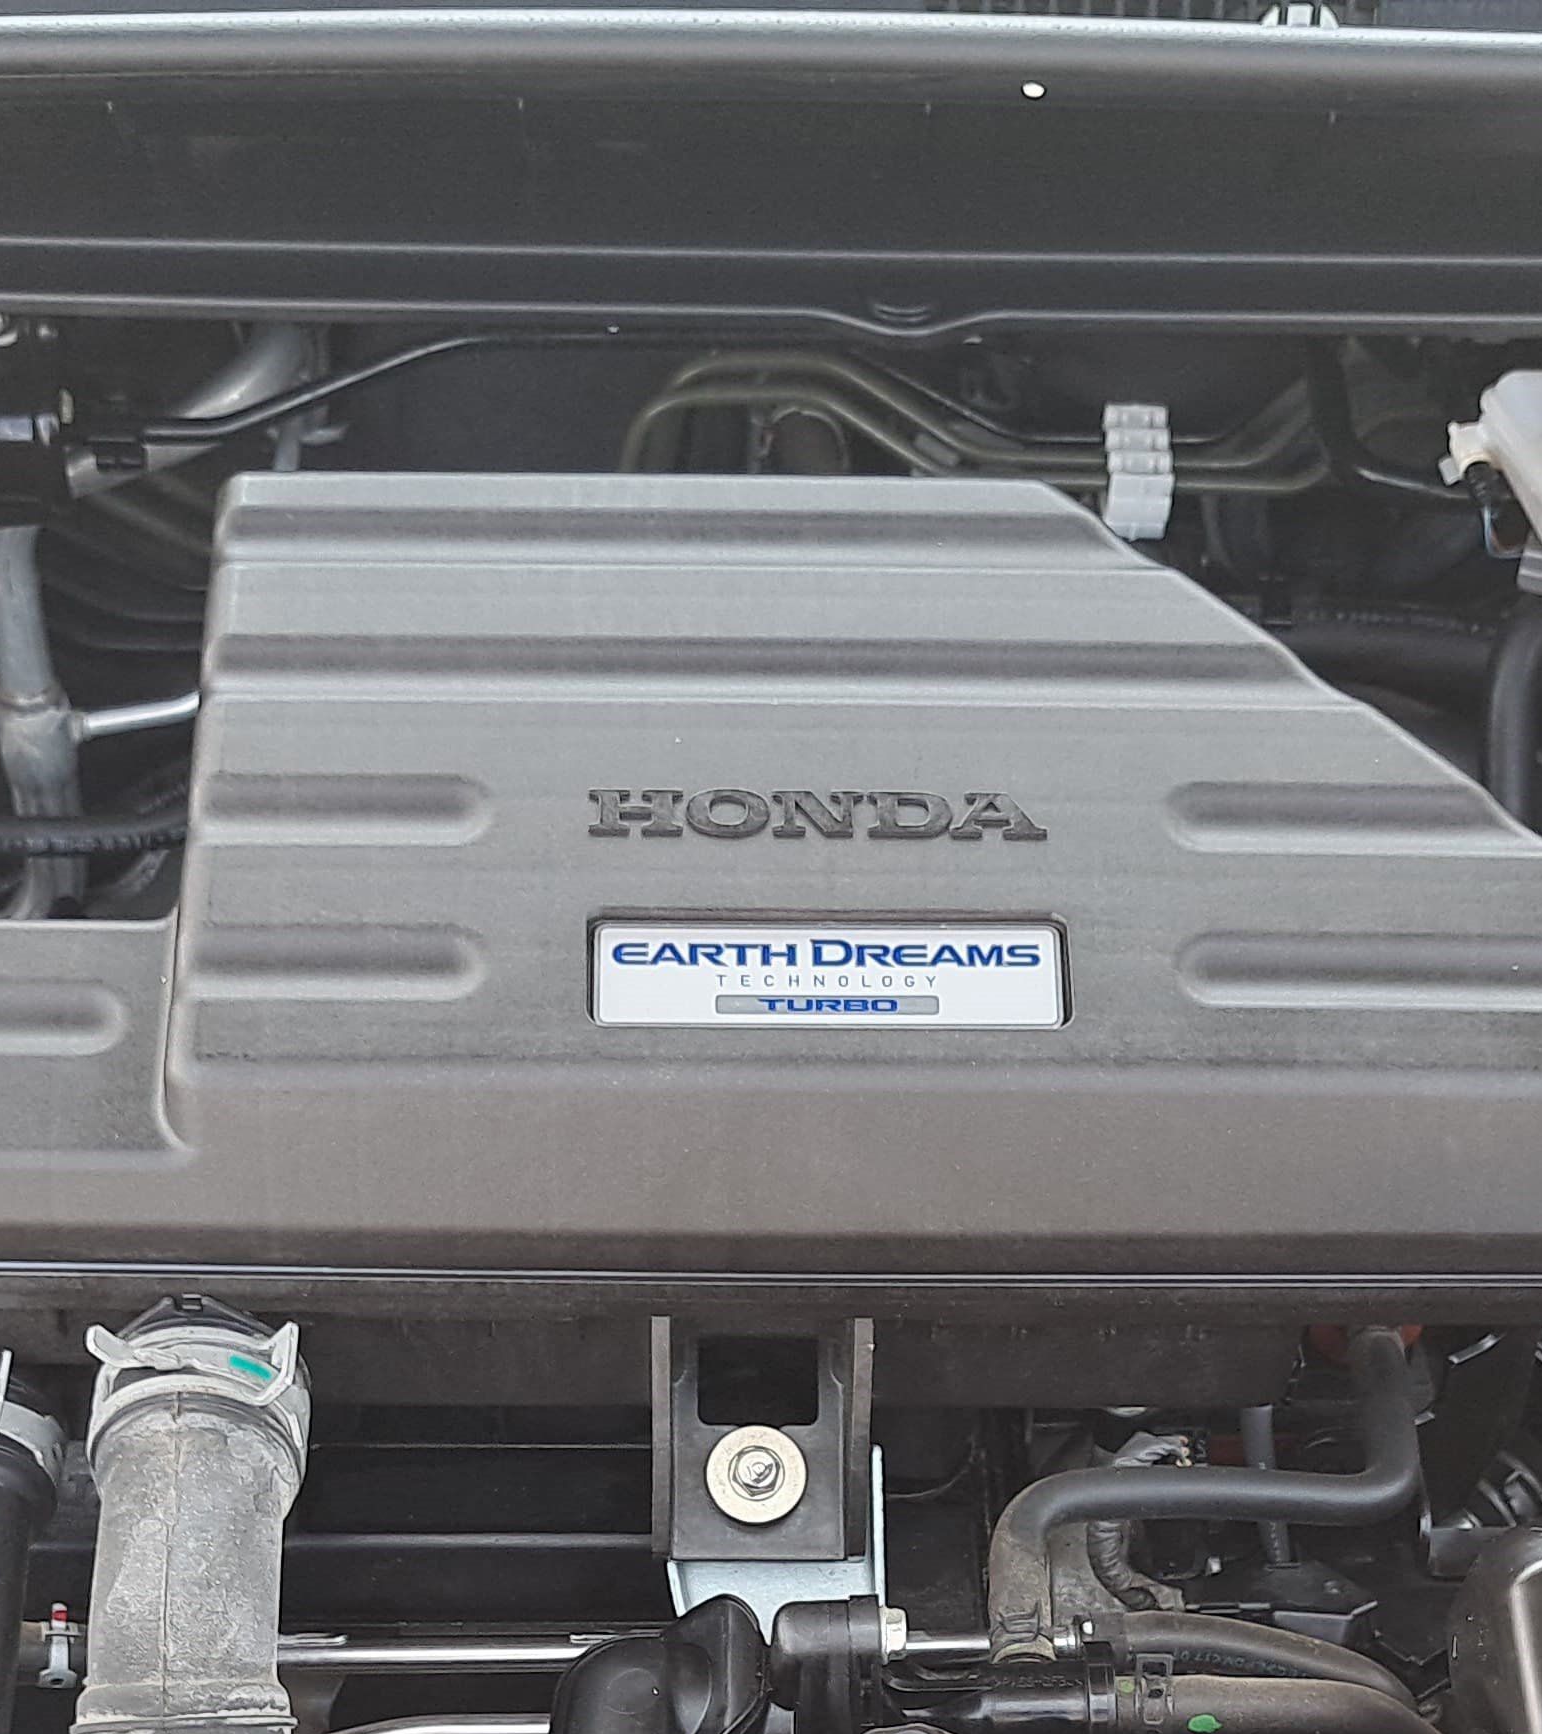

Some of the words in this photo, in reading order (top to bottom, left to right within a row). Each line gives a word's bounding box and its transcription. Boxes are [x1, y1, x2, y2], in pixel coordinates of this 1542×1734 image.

[588, 789, 1048, 840] HONDA
[612, 942, 797, 968] EARTH
[715, 973, 938, 988] TECHNOLOGY
[757, 998, 898, 1013] TURBO
